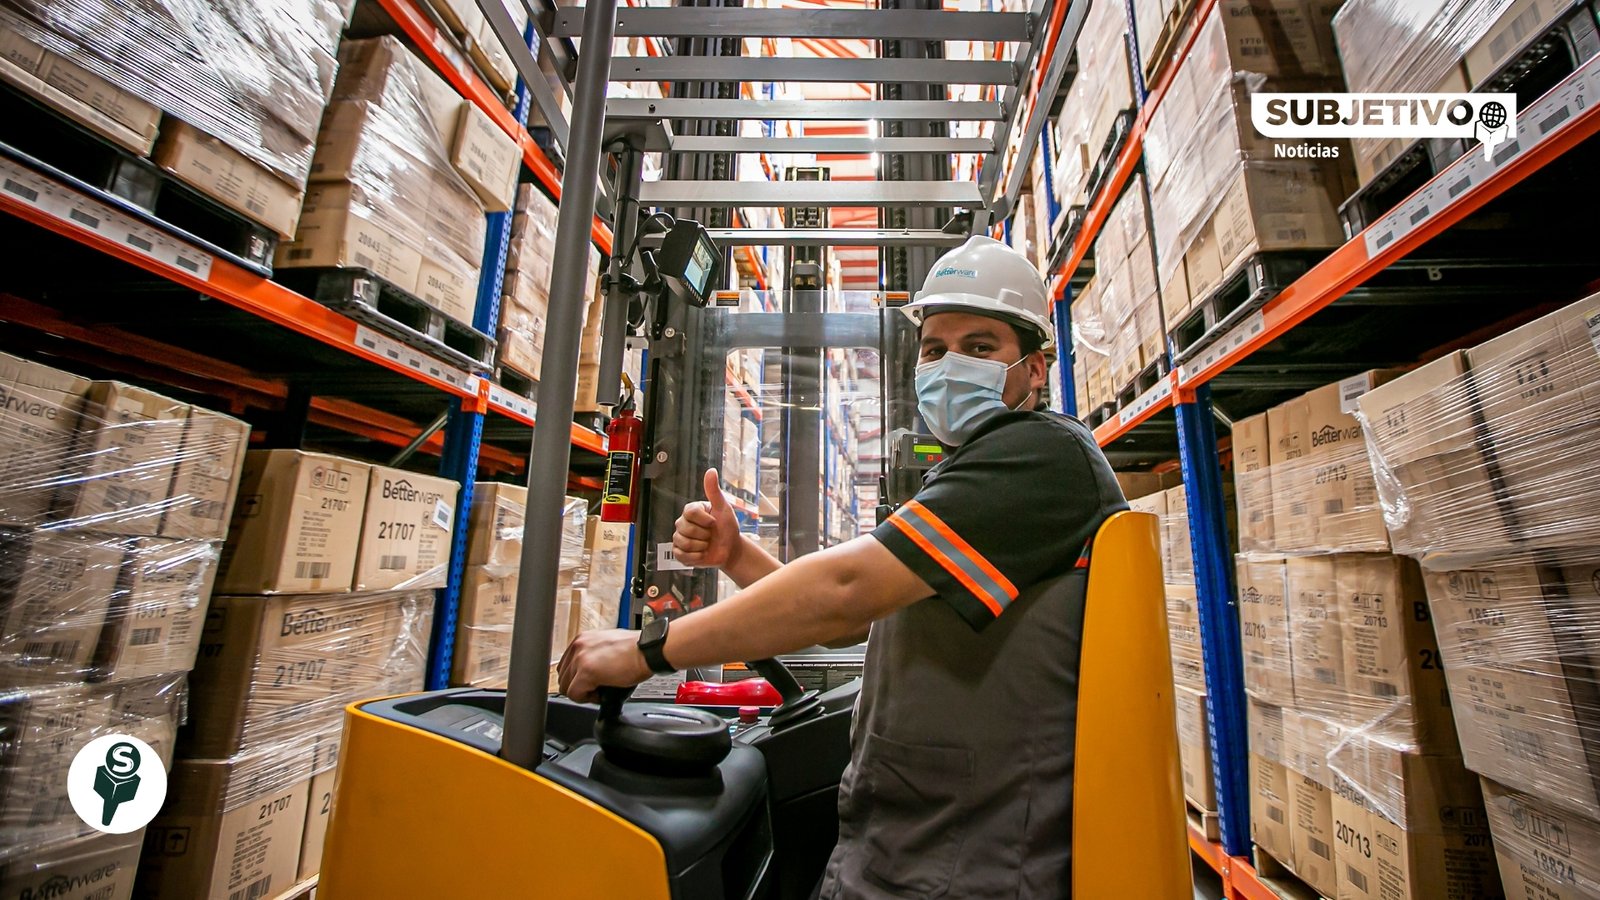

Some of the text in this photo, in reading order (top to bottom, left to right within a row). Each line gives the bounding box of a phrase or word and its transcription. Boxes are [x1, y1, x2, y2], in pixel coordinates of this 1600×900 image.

[1315, 464, 1348, 485] 20713
[321, 497, 349, 511] 21707
[378, 521, 415, 541] 21707
[1364, 615, 1388, 628] 20713
[273, 659, 326, 688] 21707
[258, 793, 293, 820] 21707
[1335, 820, 1372, 859] 20713
